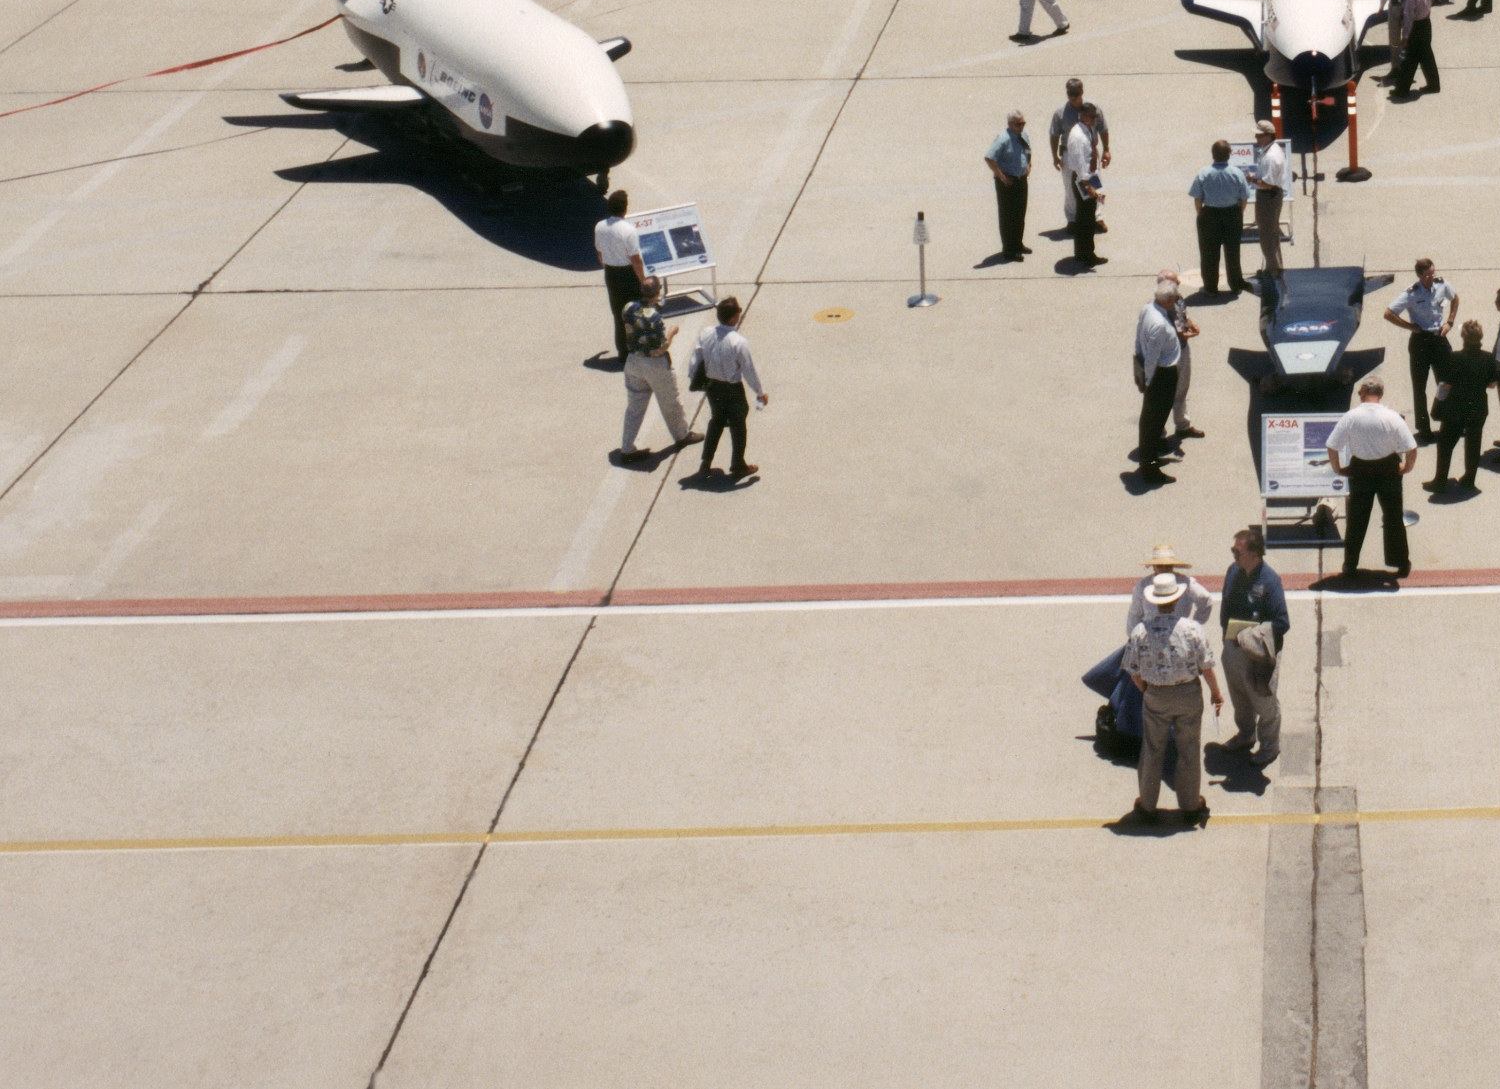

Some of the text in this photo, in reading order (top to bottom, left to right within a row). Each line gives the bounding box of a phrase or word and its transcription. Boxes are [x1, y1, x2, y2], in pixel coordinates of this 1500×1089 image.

[439, 70, 477, 104] BOEING
[634, 218, 653, 229] X-37
[1286, 324, 1330, 333] NASA
[1267, 419, 1299, 429] X-43A
